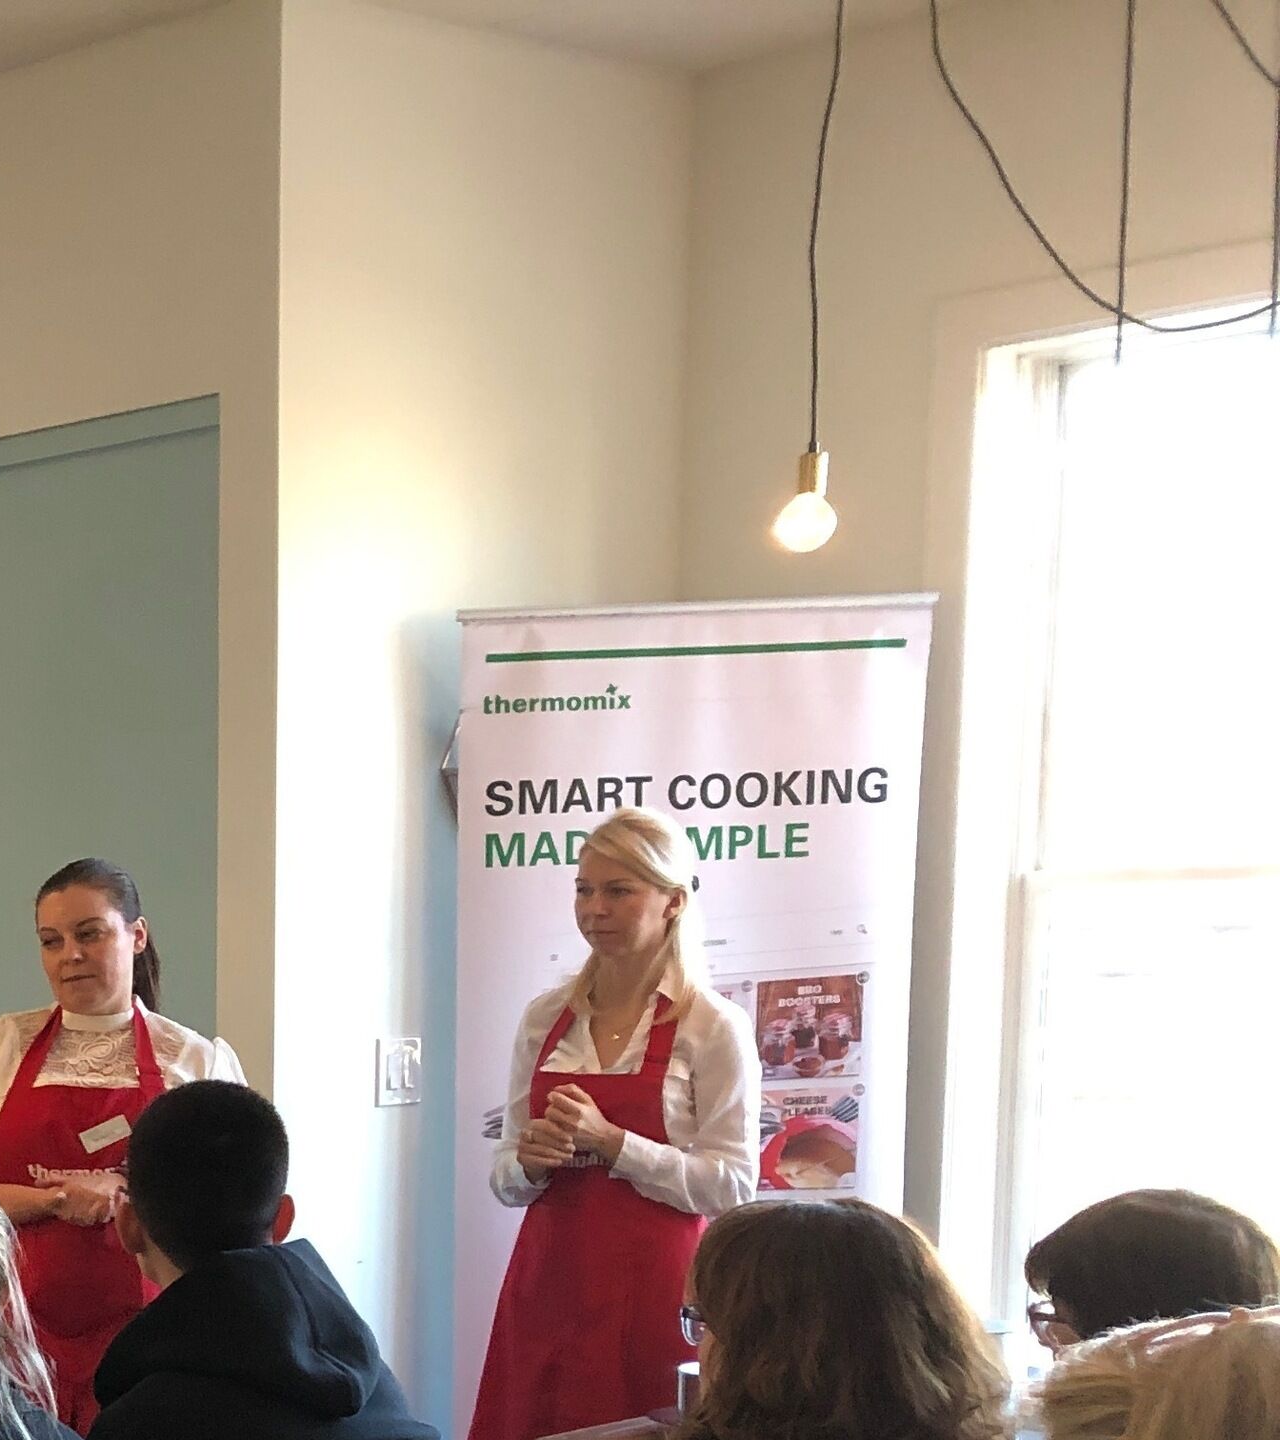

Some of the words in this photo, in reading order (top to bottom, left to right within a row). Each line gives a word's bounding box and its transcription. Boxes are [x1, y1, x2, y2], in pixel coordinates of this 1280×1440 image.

[483, 683, 632, 714] thermomix
[484, 776, 653, 816] SMART
[668, 767, 889, 810] COOKING
[485, 830, 591, 868] MAD
[685, 822, 810, 861] MPLE
[782, 1095, 828, 1106] CHEESE
